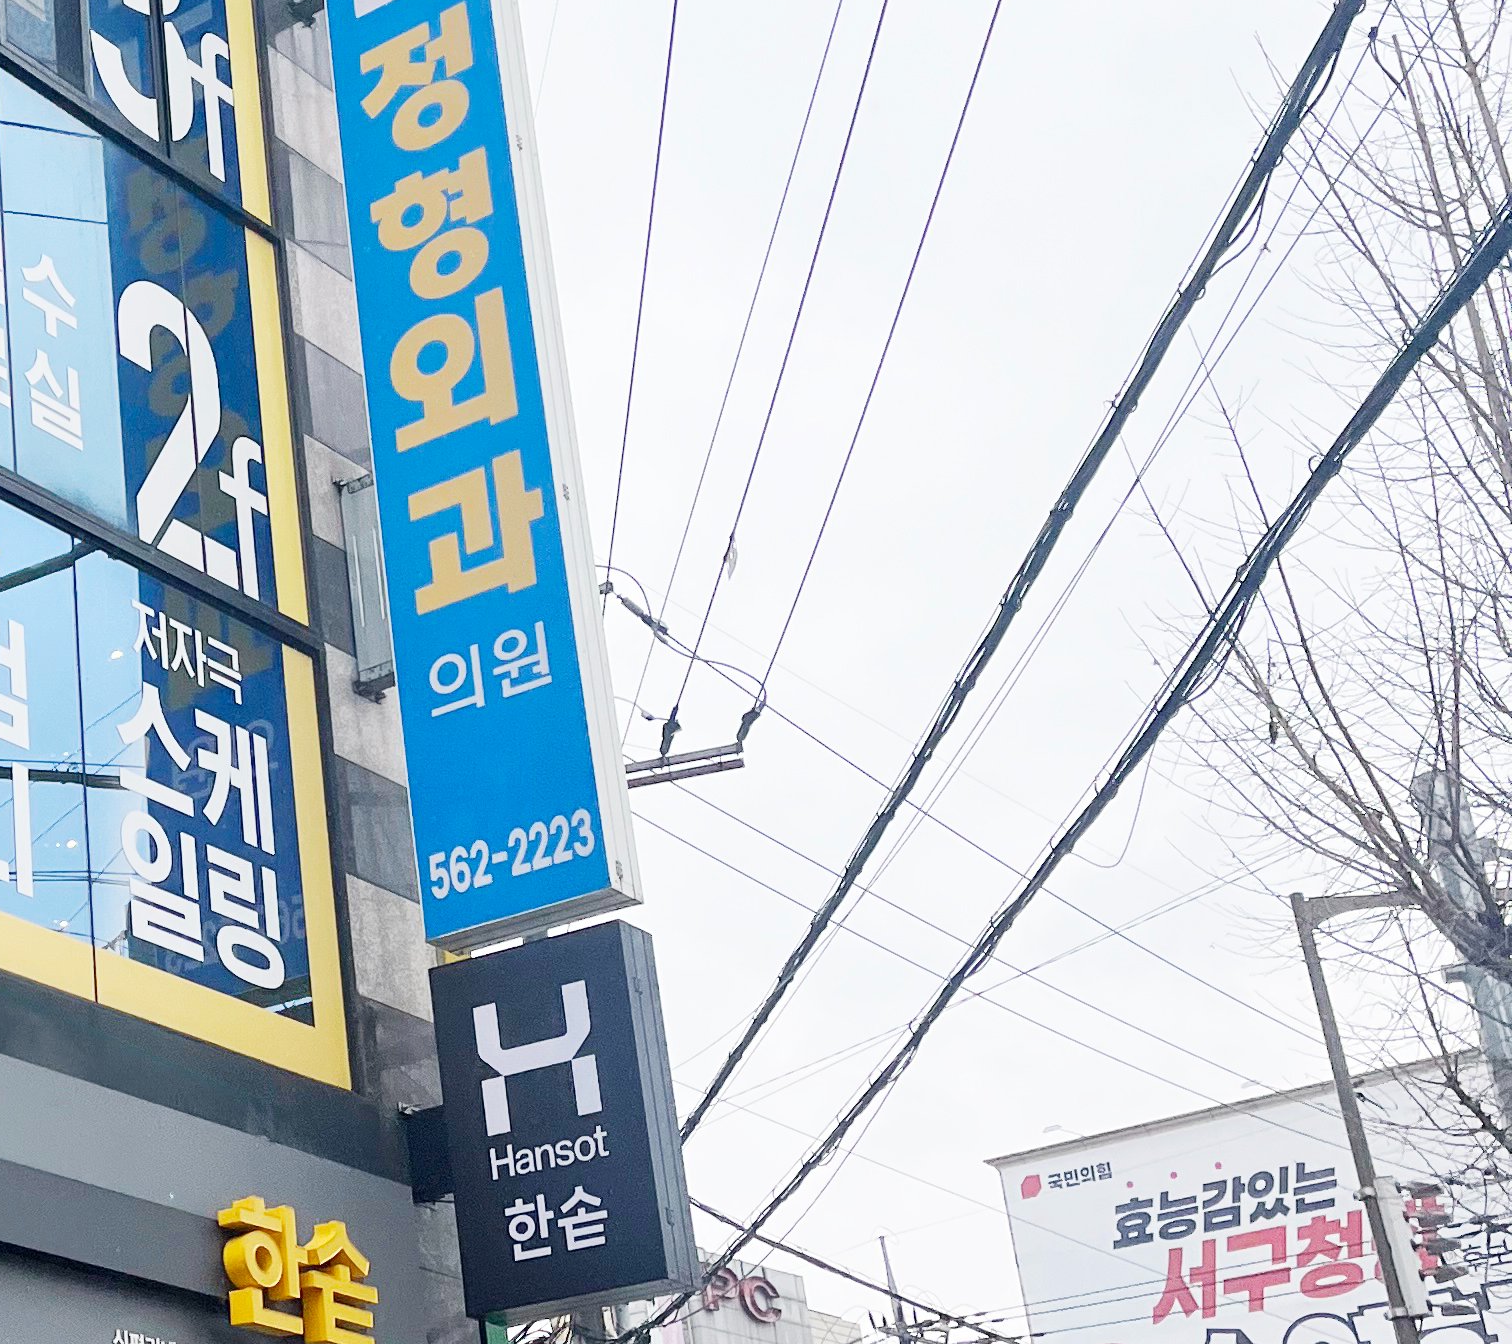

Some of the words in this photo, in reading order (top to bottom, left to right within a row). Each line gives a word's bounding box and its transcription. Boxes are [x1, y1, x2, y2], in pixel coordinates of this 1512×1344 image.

[131, 597, 242, 707] 저자극
[429, 620, 553, 718] 의원
[117, 686, 276, 858] 스케
[119, 807, 287, 991] 일링
[428, 808, 596, 901] 562-2223
[489, 1124, 610, 1182] Hansot
[1046, 1159, 1114, 1191] 국민의힘
[504, 1184, 608, 1262] 한솥
[1112, 1161, 1338, 1250] 효능감있는
[703, 1267, 783, 1324] PC
